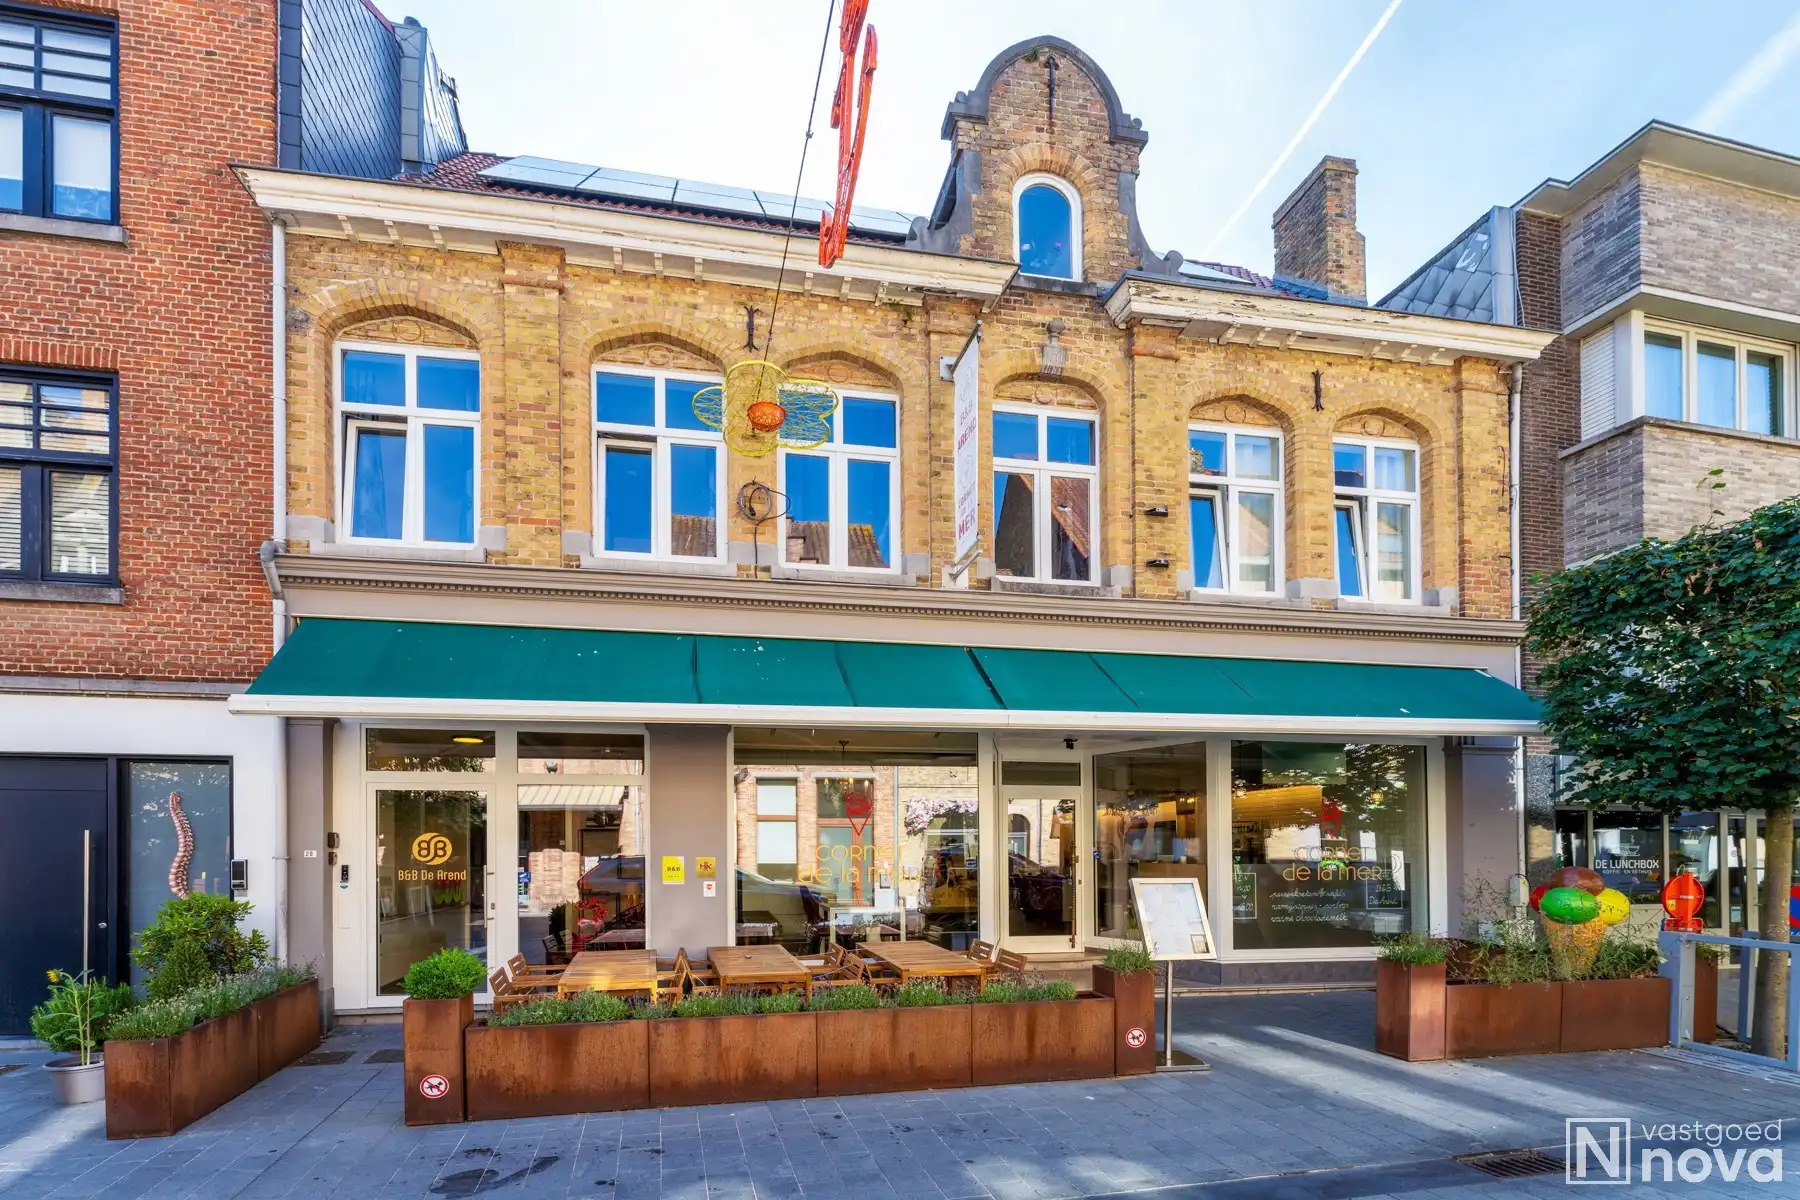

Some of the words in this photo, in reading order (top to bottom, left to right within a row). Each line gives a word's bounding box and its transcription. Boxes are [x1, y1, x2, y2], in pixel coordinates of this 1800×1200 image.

[958, 507, 976, 541] MER
[1282, 863, 1311, 881] de
[1317, 863, 1333, 881] la
[1595, 859, 1608, 869] DE
[1609, 859, 1660, 869] LUNCHBOX
[398, 869, 418, 881] B&B
[421, 869, 434, 881] De
[437, 869, 467, 881] Arend
[797, 863, 832, 884] de
[840, 863, 860, 883] la
